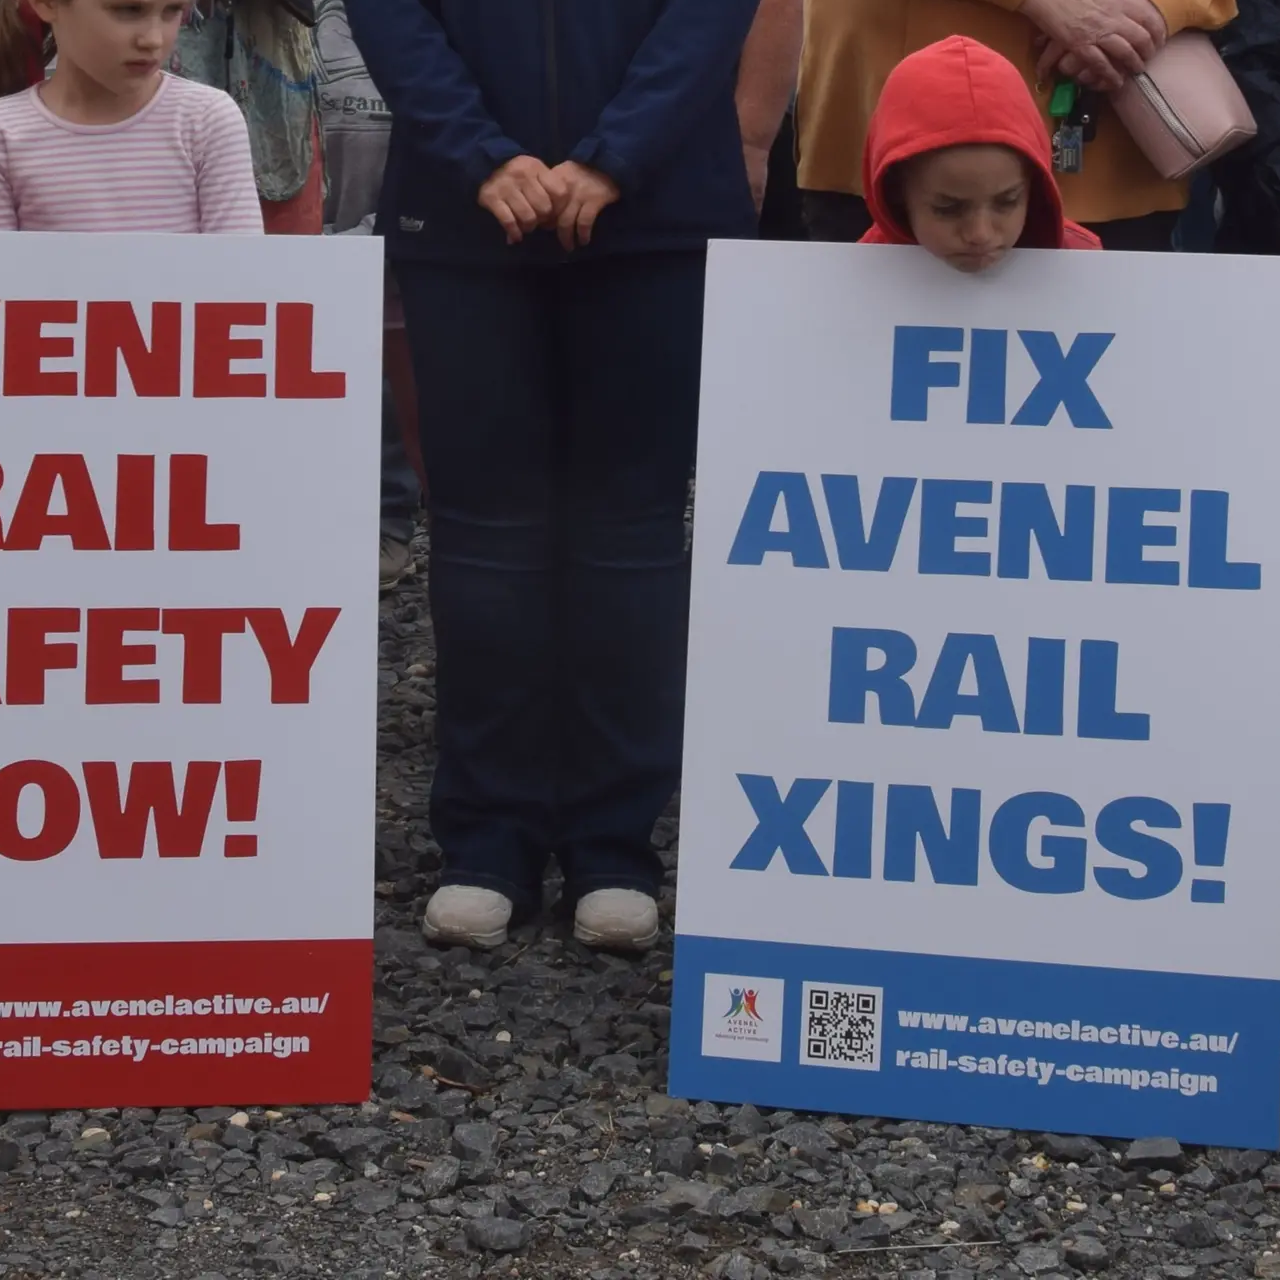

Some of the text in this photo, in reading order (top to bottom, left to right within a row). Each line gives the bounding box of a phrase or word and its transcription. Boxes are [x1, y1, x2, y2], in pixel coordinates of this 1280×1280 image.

[891, 326, 1116, 429] FIX
[727, 471, 1261, 590] AVENEL
[828, 627, 1151, 741] RAIL
[730, 774, 1231, 904] XINGS!
[727, 1019, 758, 1027] AVENEL
[728, 1027, 757, 1035] ACTIVE
[897, 1010, 1239, 1054] www.avenelactive.au/
[896, 1049, 1218, 1096] rail-safety-campaign
